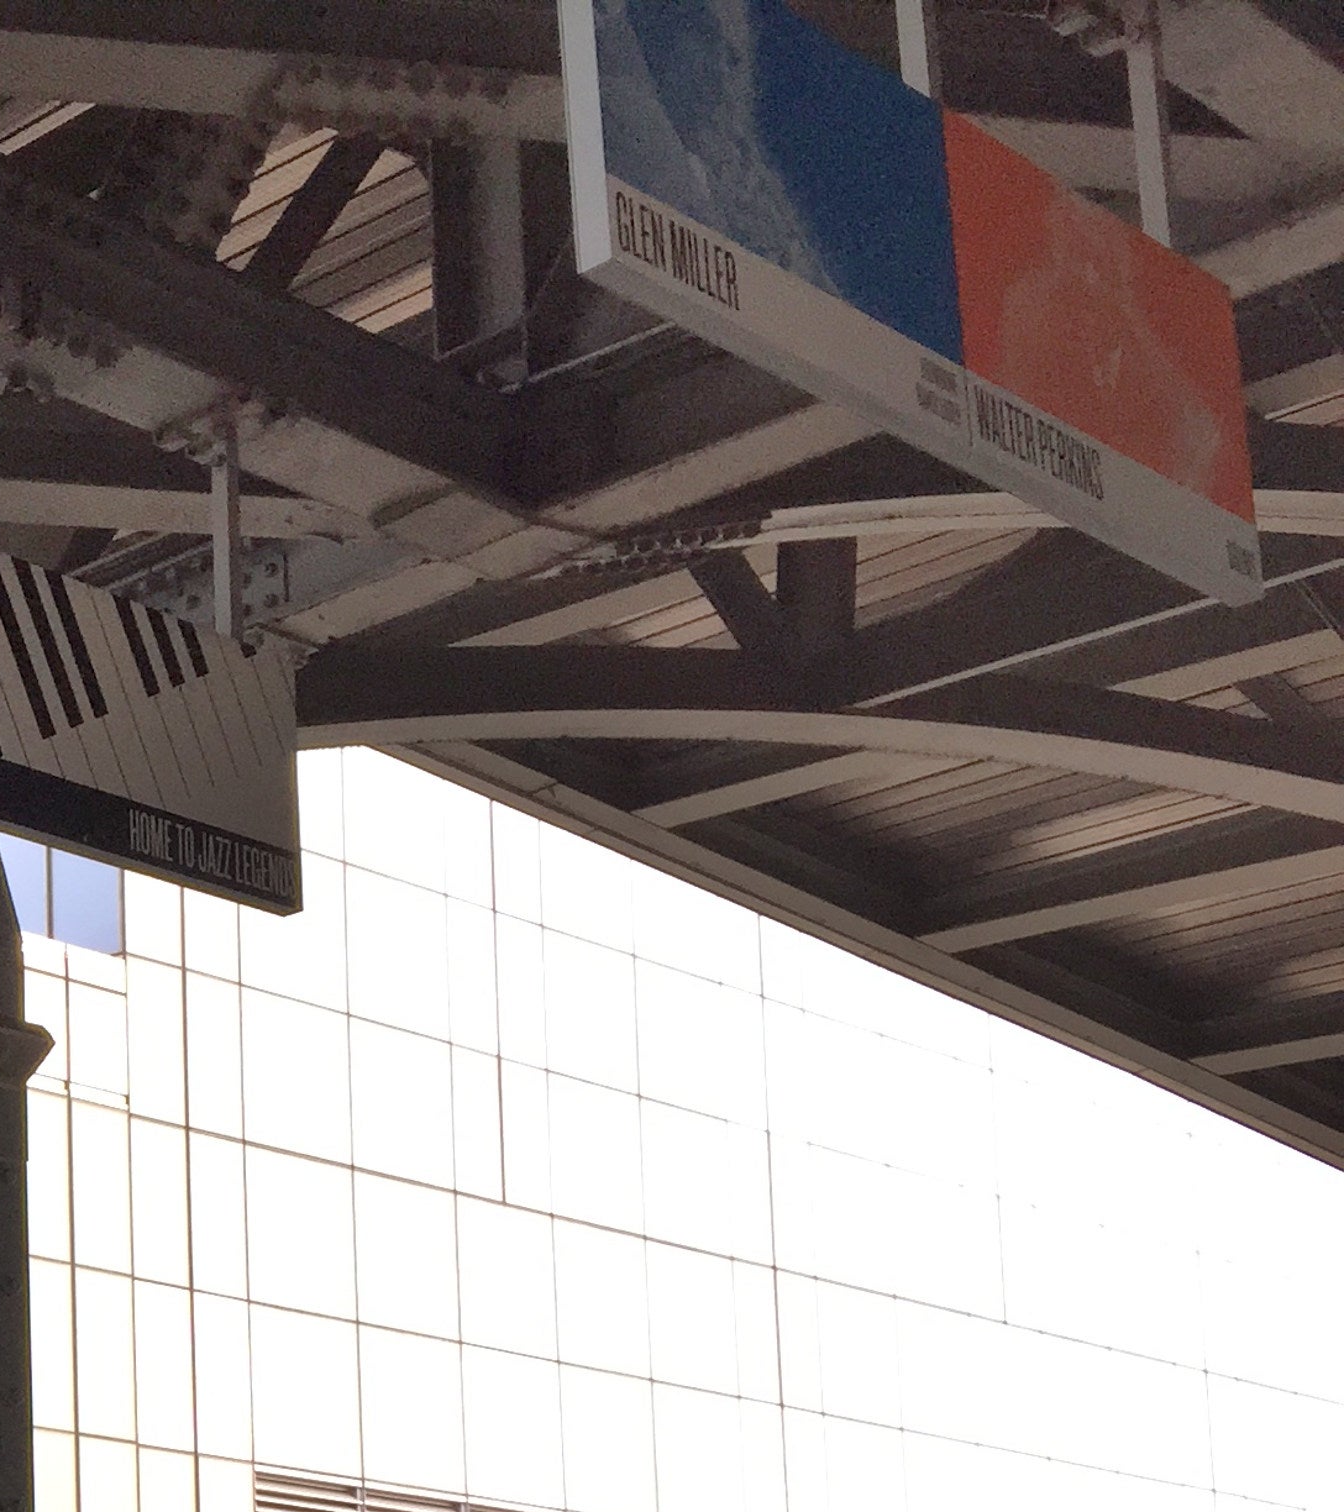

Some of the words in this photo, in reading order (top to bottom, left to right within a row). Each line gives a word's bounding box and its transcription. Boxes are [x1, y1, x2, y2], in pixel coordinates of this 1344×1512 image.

[616, 191, 667, 272] GLEN
[669, 219, 740, 311] MILLER
[973, 383, 1037, 466] WALTER
[129, 808, 173, 863] HOME
[175, 823, 195, 869] TO
[198, 829, 232, 880] JAZZ
